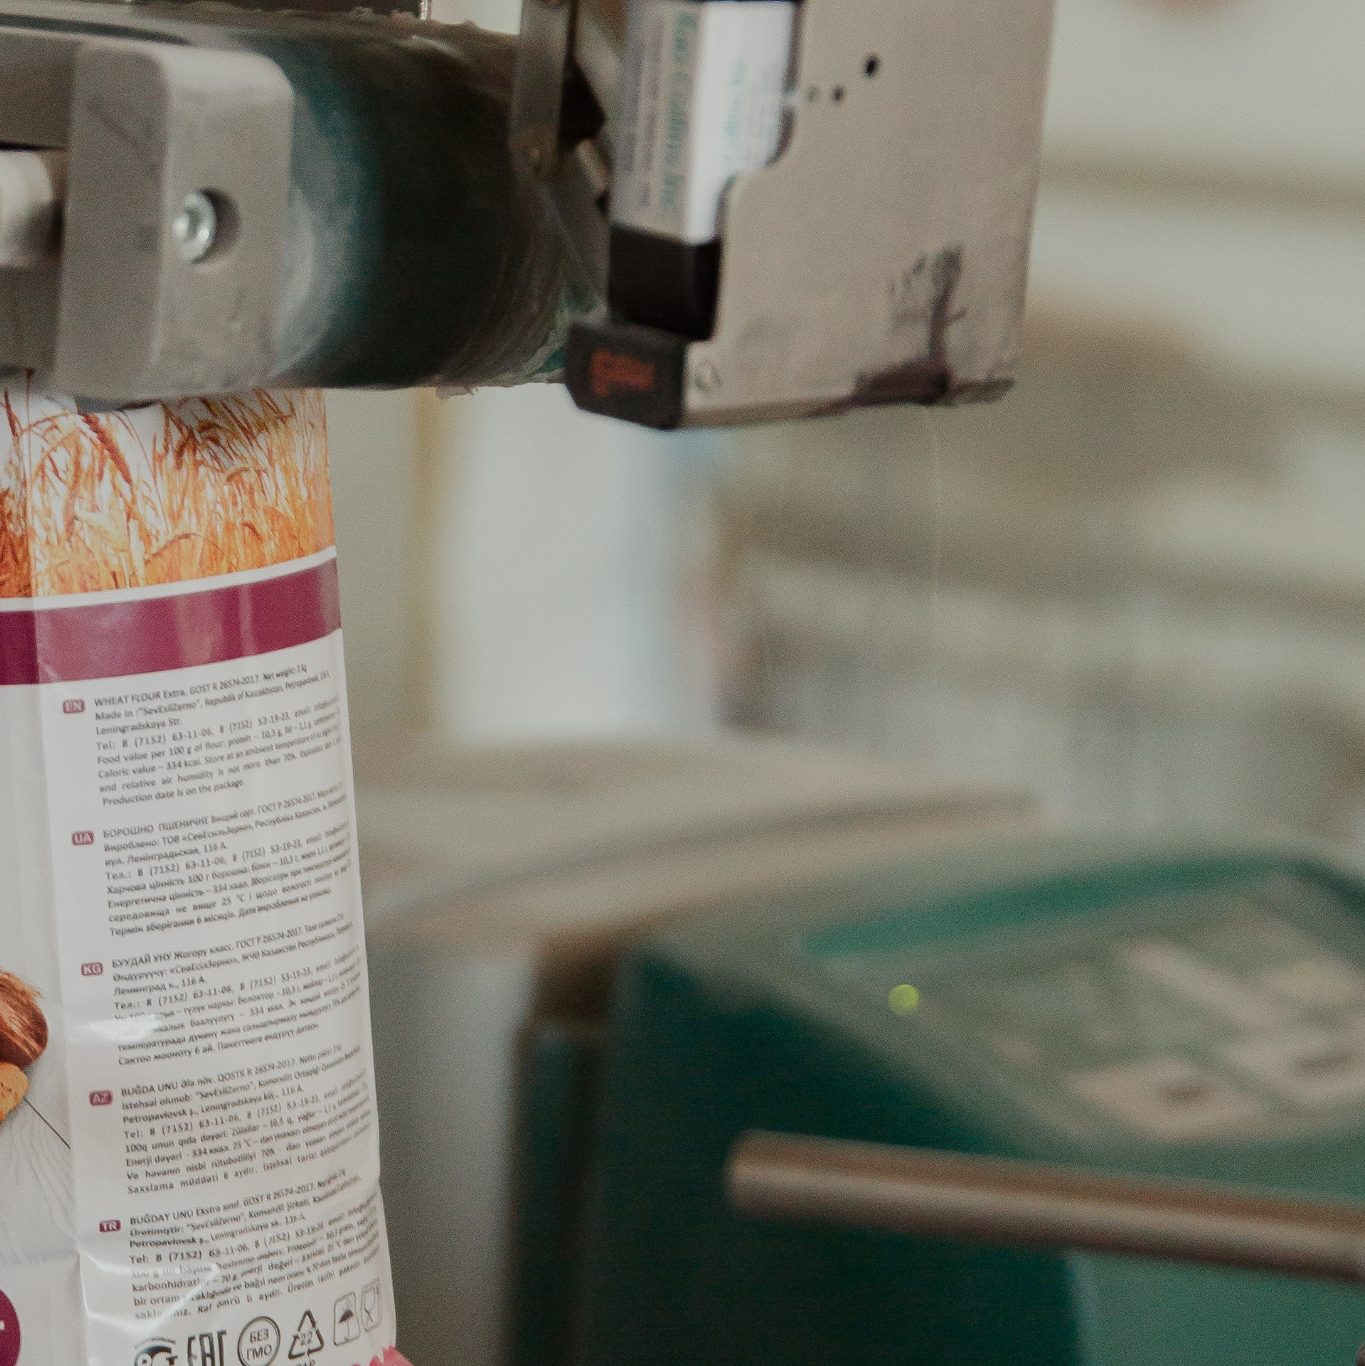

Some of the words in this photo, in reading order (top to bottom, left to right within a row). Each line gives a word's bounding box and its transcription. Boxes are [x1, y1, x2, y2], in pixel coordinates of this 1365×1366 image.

[95, 710, 122, 722] Made
[97, 753, 120, 766] Food
[123, 750, 147, 762] value
[168, 745, 184, 756] 100
[99, 783, 116, 793] and
[102, 793, 152, 807] Production
[155, 789, 174, 799] date
[103, 823, 154, 839] БОРОШНО
[102, 1221, 117, 1232] TR
[249, 1328, 270, 1343] БЕЗ
[246, 1343, 273, 1362] ГМО
